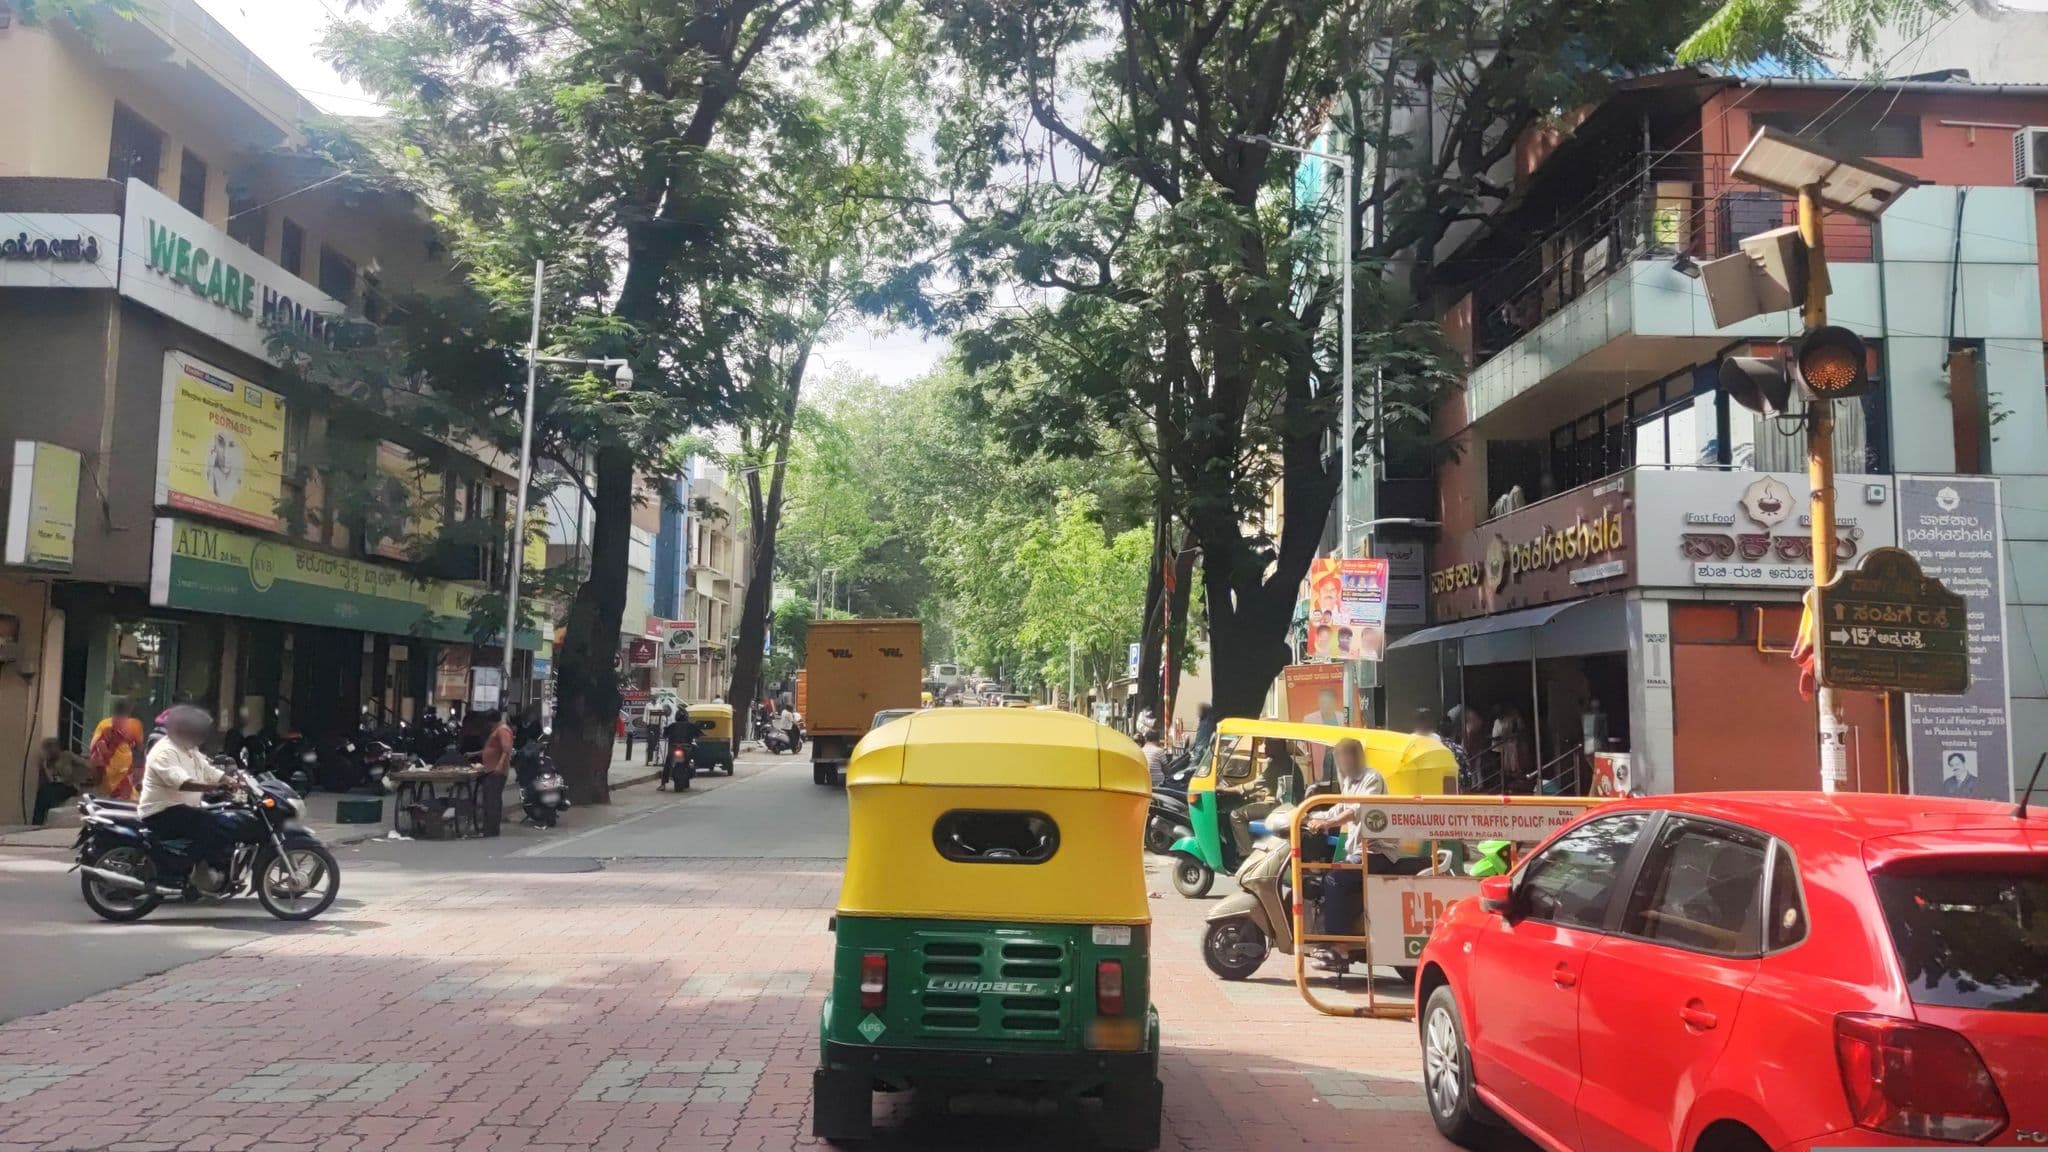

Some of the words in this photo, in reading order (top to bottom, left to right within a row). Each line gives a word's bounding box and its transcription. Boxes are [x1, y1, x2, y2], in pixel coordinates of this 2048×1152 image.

[147, 218, 256, 319] WECARE
[1687, 513, 1709, 522] Fast
[1712, 513, 1736, 523] Food
[1906, 527, 1993, 543] paakashala
[176, 529, 219, 560] ATM
[220, 551, 229, 562] 24
[1912, 704, 1927, 713] The
[1928, 706, 1964, 714] restaurant
[1965, 705, 1978, 714] will
[1979, 707, 2003, 716] reopen
[1922, 716, 1934, 724] the
[1935, 716, 1946, 724] 1st
[1946, 716, 1954, 724] of
[1955, 716, 1986, 726] February
[1968, 738, 1977, 748] by
[1391, 813, 1446, 826] BENGALURU
[1447, 814, 1469, 826] CITY
[1471, 814, 1509, 827] TRAFFIC
[925, 978, 1038, 994] Compact
[863, 1023, 881, 1032] LPG
